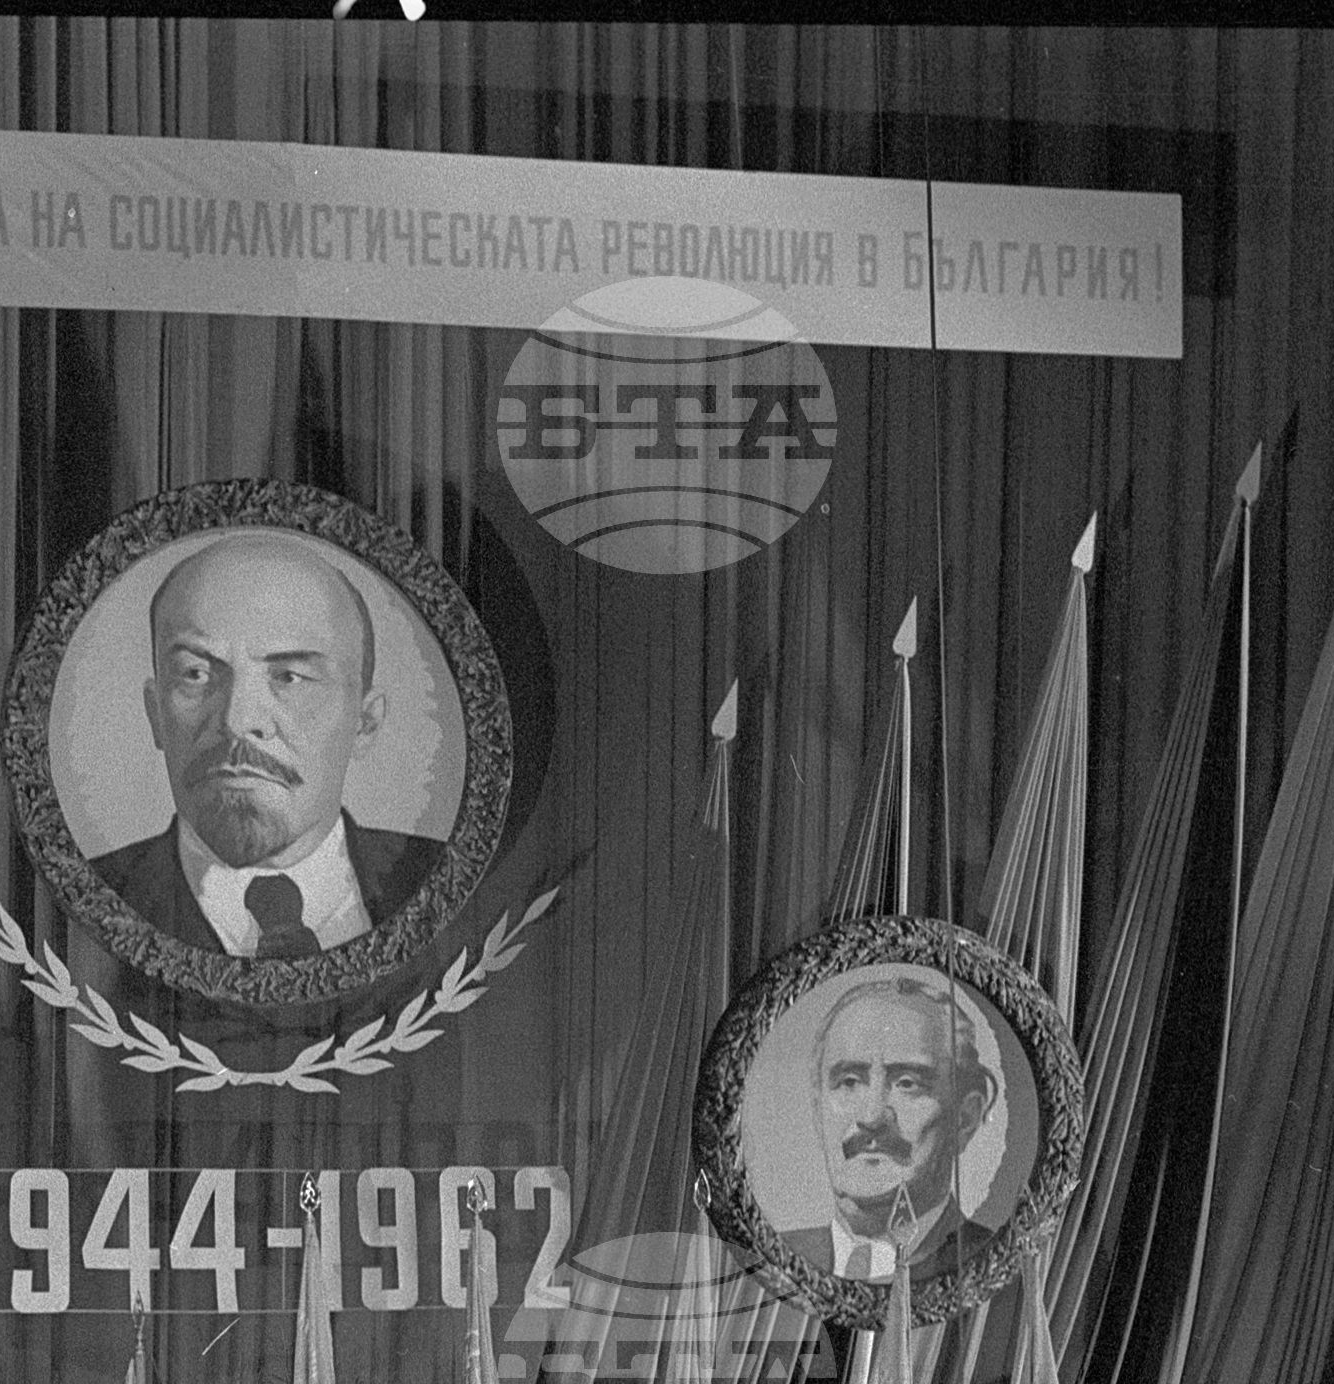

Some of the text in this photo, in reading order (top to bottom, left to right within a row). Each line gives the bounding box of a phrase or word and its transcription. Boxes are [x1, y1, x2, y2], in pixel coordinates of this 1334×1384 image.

[30, 188, 87, 248] НА
[109, 193, 579, 274] СОЦИАЛИСТИЧЕСКАТА
[601, 219, 835, 290] РЕВОЛЮЦИЯ
[857, 232, 879, 289] В
[902, 231, 1165, 303] БЪЛГАРИЯ!
